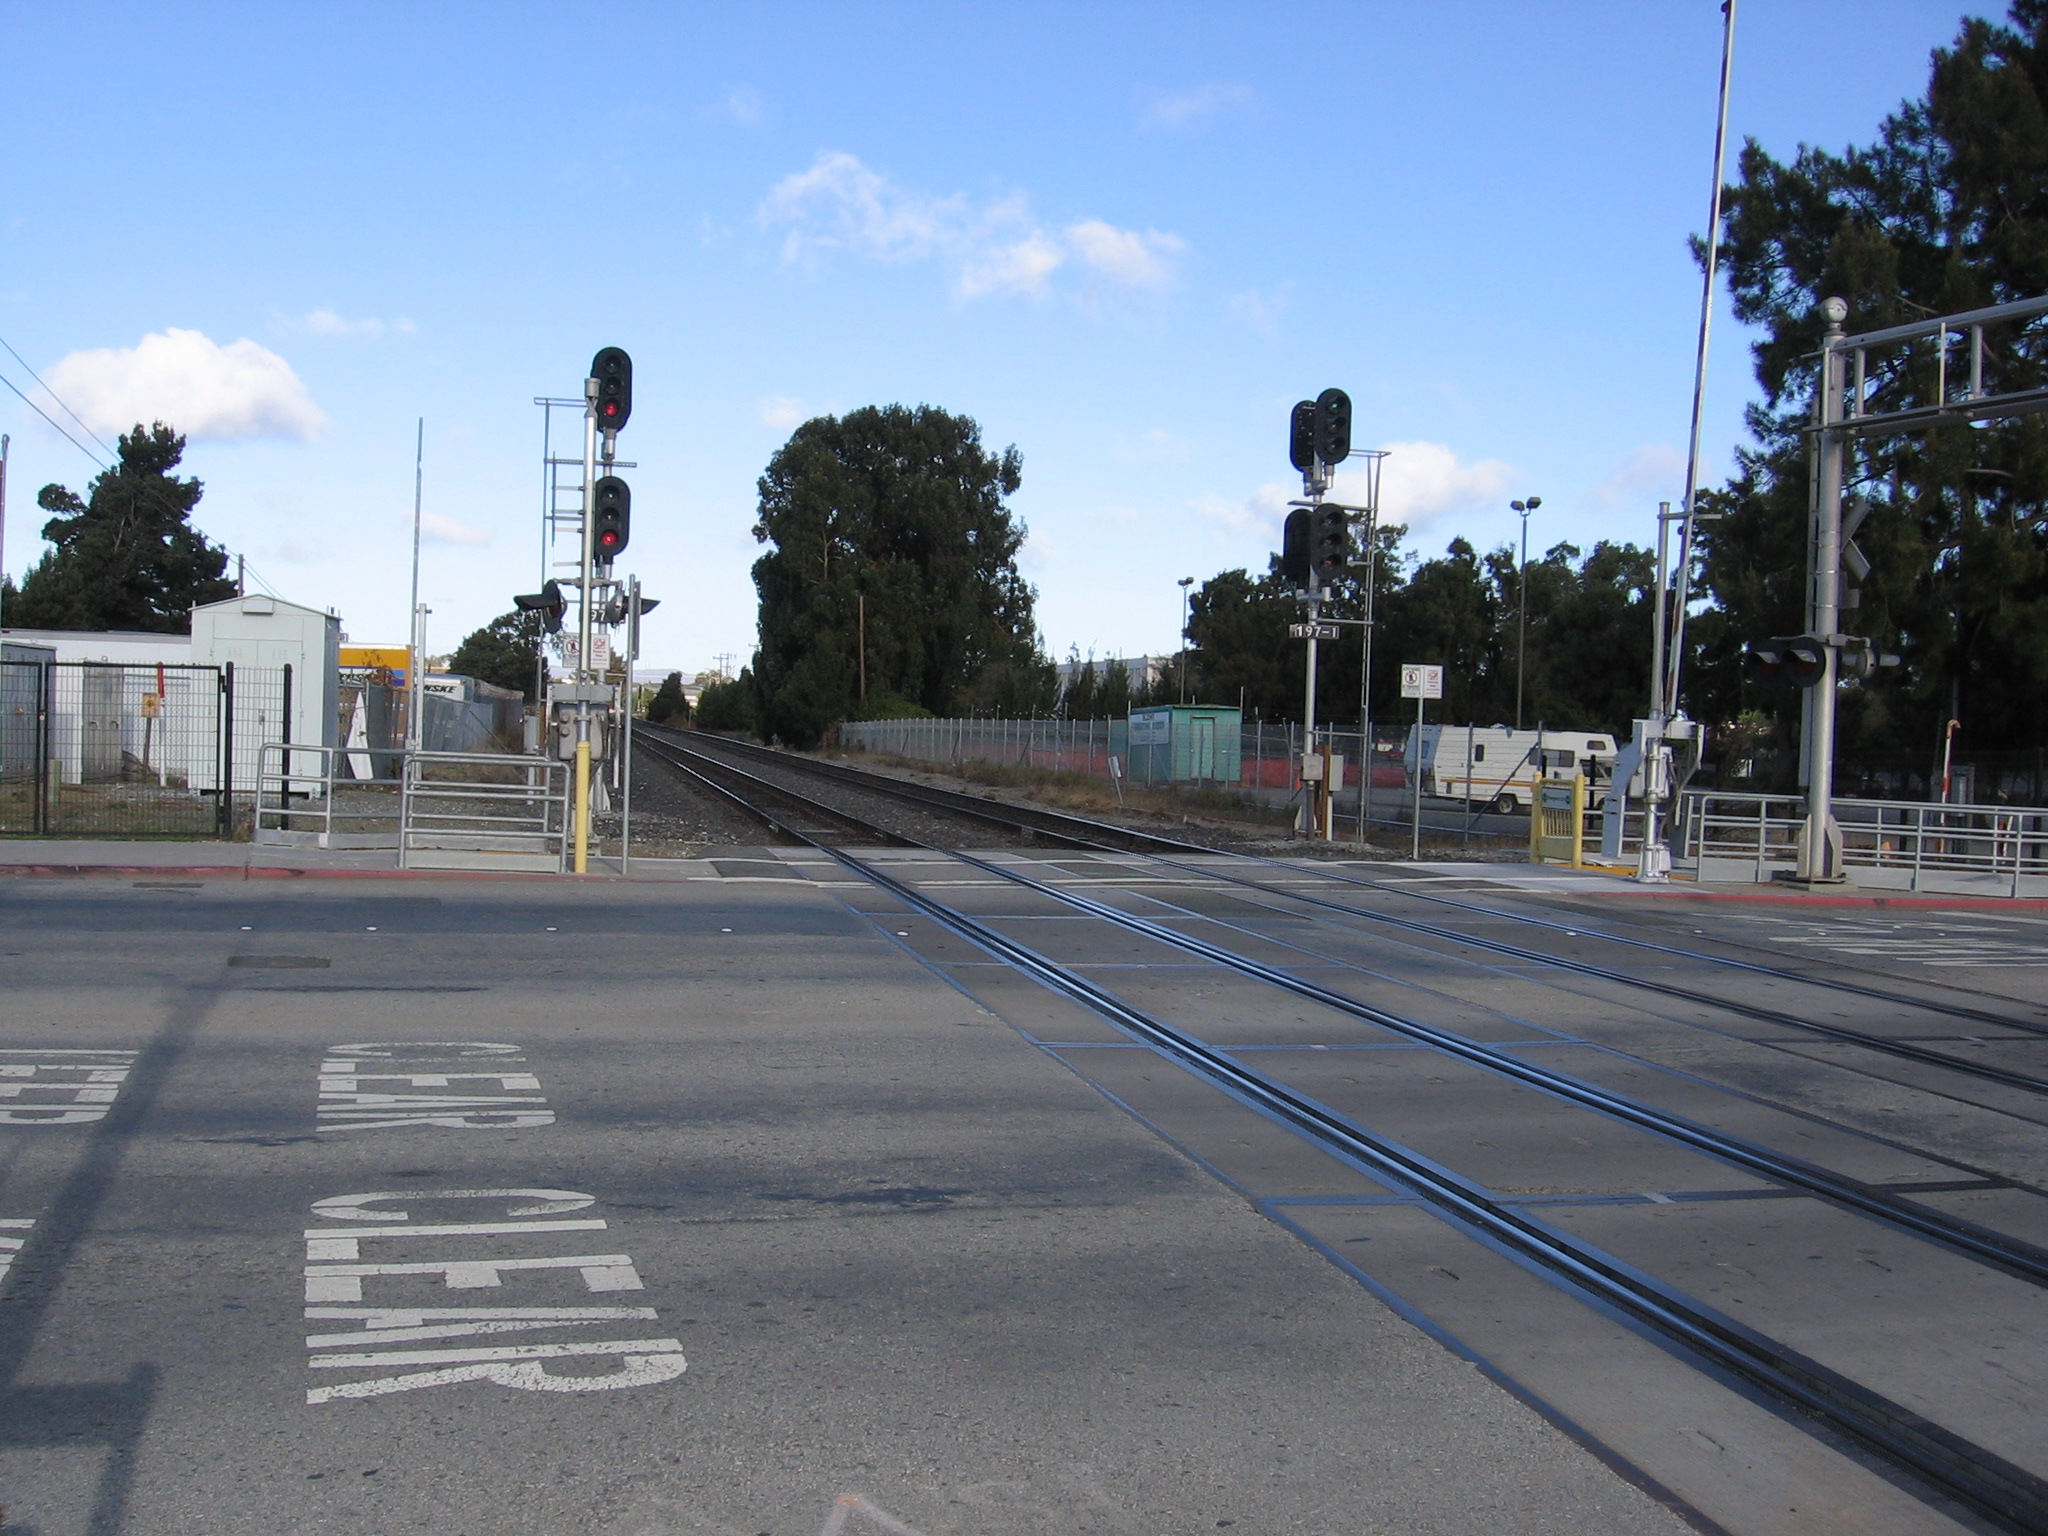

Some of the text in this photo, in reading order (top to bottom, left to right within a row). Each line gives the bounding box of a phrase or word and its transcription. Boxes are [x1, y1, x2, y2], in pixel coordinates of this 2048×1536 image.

[1296, 625, 1336, 639] 197-1
[316, 1041, 556, 1133] CLEAR
[303, 1188, 688, 1405] CLEAR
